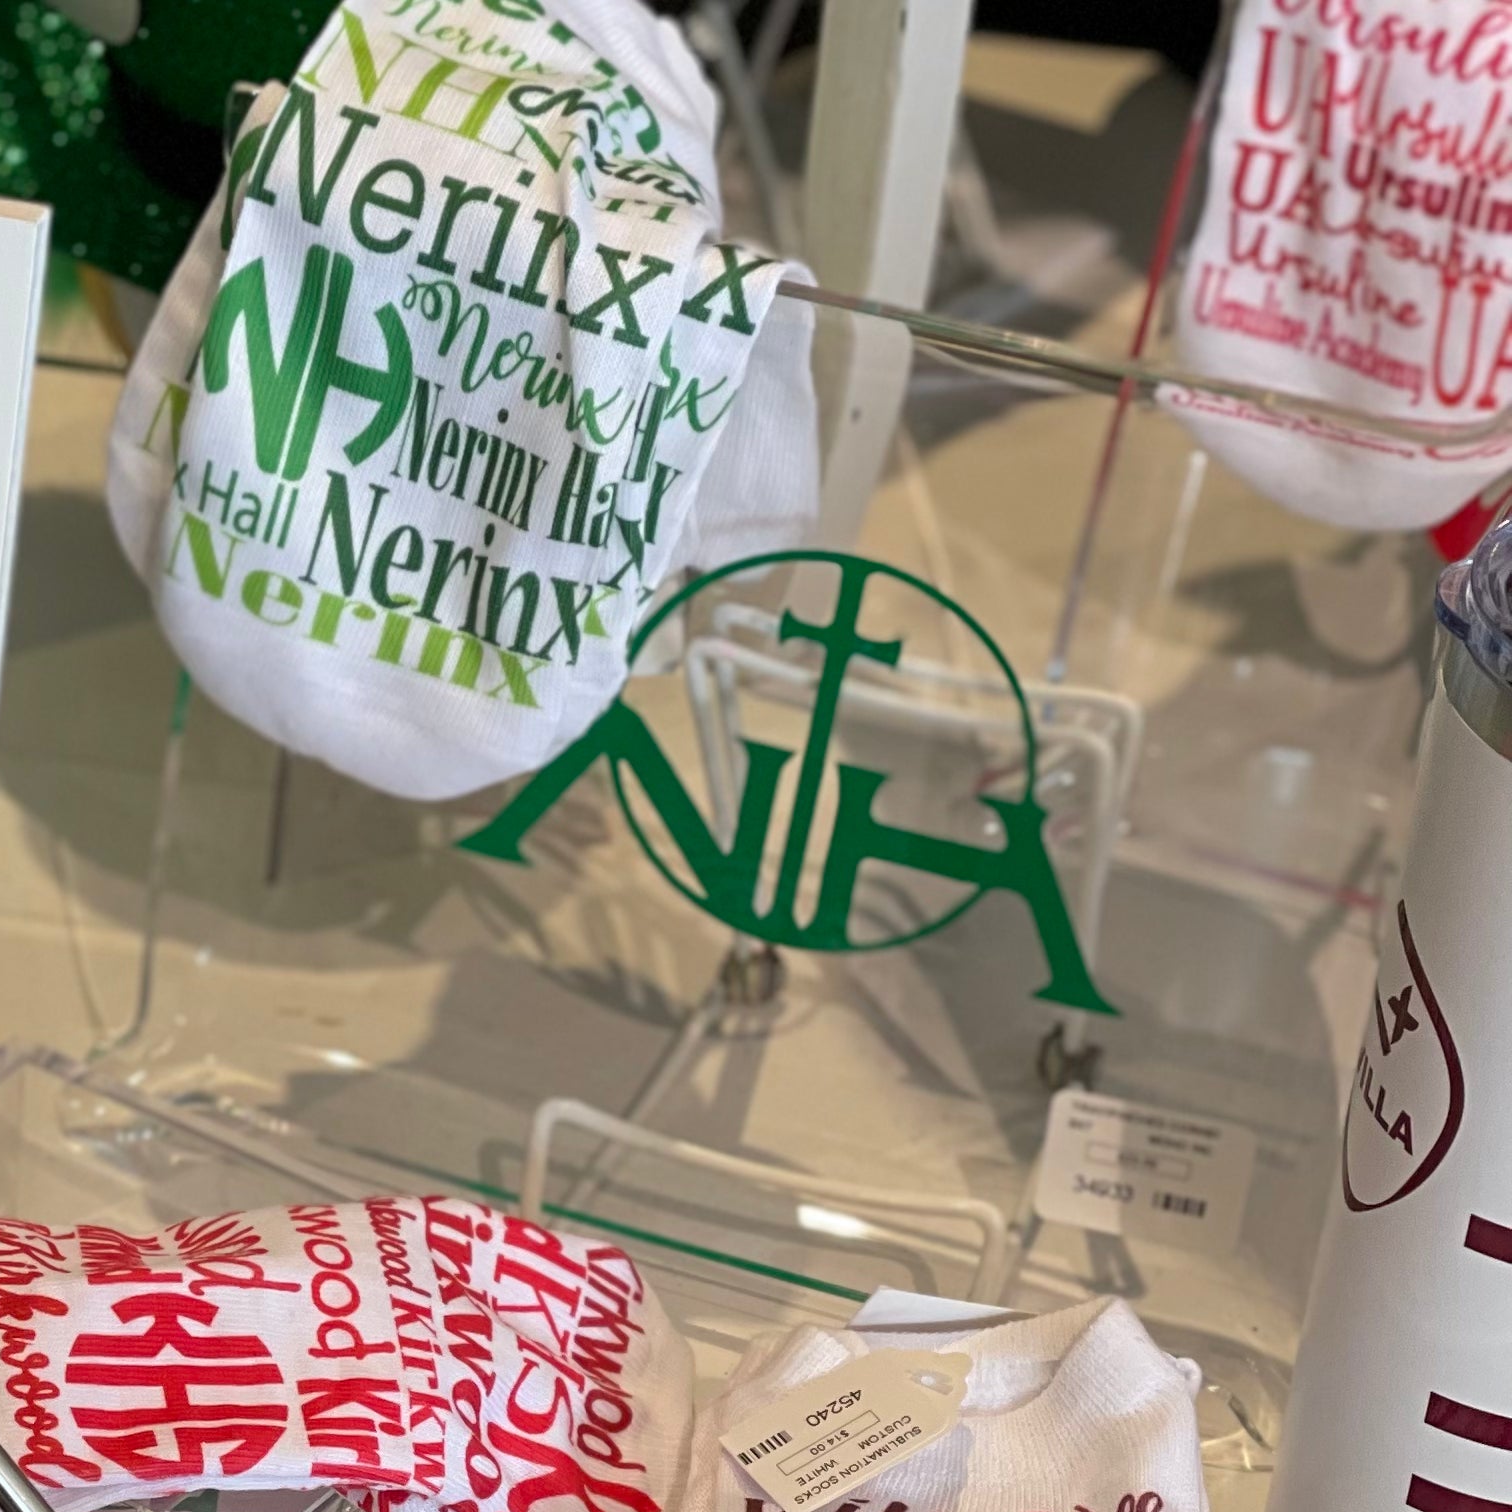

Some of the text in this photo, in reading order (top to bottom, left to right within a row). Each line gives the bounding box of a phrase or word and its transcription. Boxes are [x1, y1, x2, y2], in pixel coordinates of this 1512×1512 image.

[245, 80, 675, 350] Nerinx
[1346, 142, 1512, 235] Ursulin
[390, 376, 550, 532] Nerinx
[197, 458, 299, 549] Hall
[298, 469, 595, 666] Nerinx
[794, 1415, 912, 1487] CUSTOM WHITE
[805, 1389, 863, 1428] 45240
[793, 1426, 922, 1505] SUBLIMATION SOCKS
